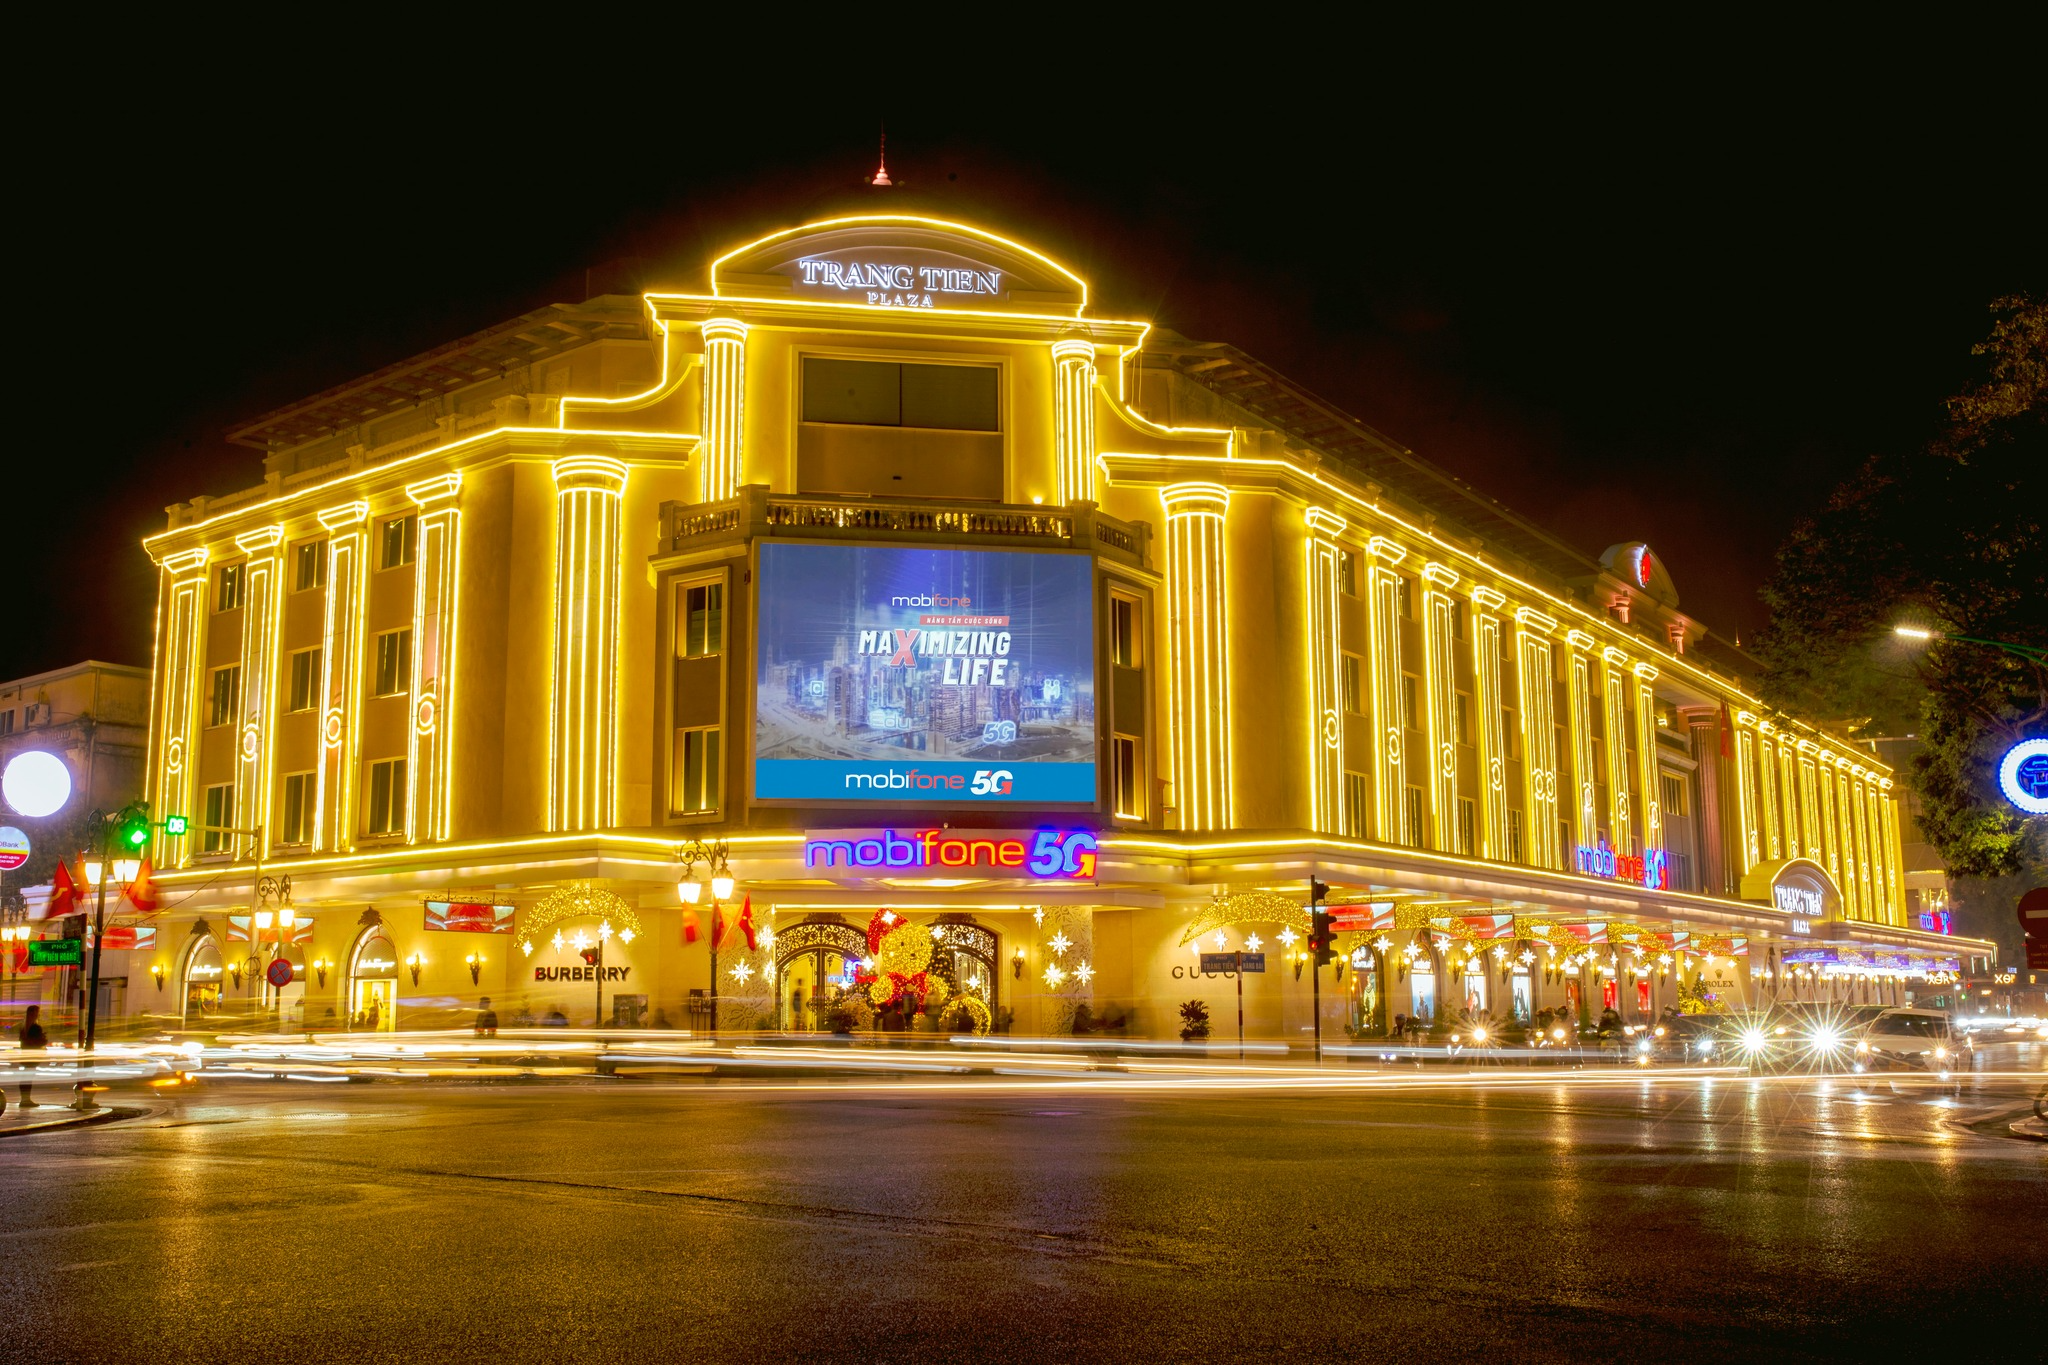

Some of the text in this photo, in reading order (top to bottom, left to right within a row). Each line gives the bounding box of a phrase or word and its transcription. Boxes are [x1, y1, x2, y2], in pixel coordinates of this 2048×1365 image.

[800, 260, 1001, 294] TRANG TIEN
[867, 291, 934, 307] PLAZA
[892, 593, 970, 607] mobifone
[858, 629, 1011, 669] MAXIMIZING
[941, 659, 1008, 687] LIFE
[870, 711, 911, 730] Edu
[983, 720, 1016, 743] 5G
[845, 769, 1013, 795] mobifone 5G
[806, 830, 1097, 878] mobifone 5G
[1577, 839, 1668, 890] mobifone 5G
[535, 966, 632, 981] BURBERRY
[1705, 980, 1734, 988] ROLEX
